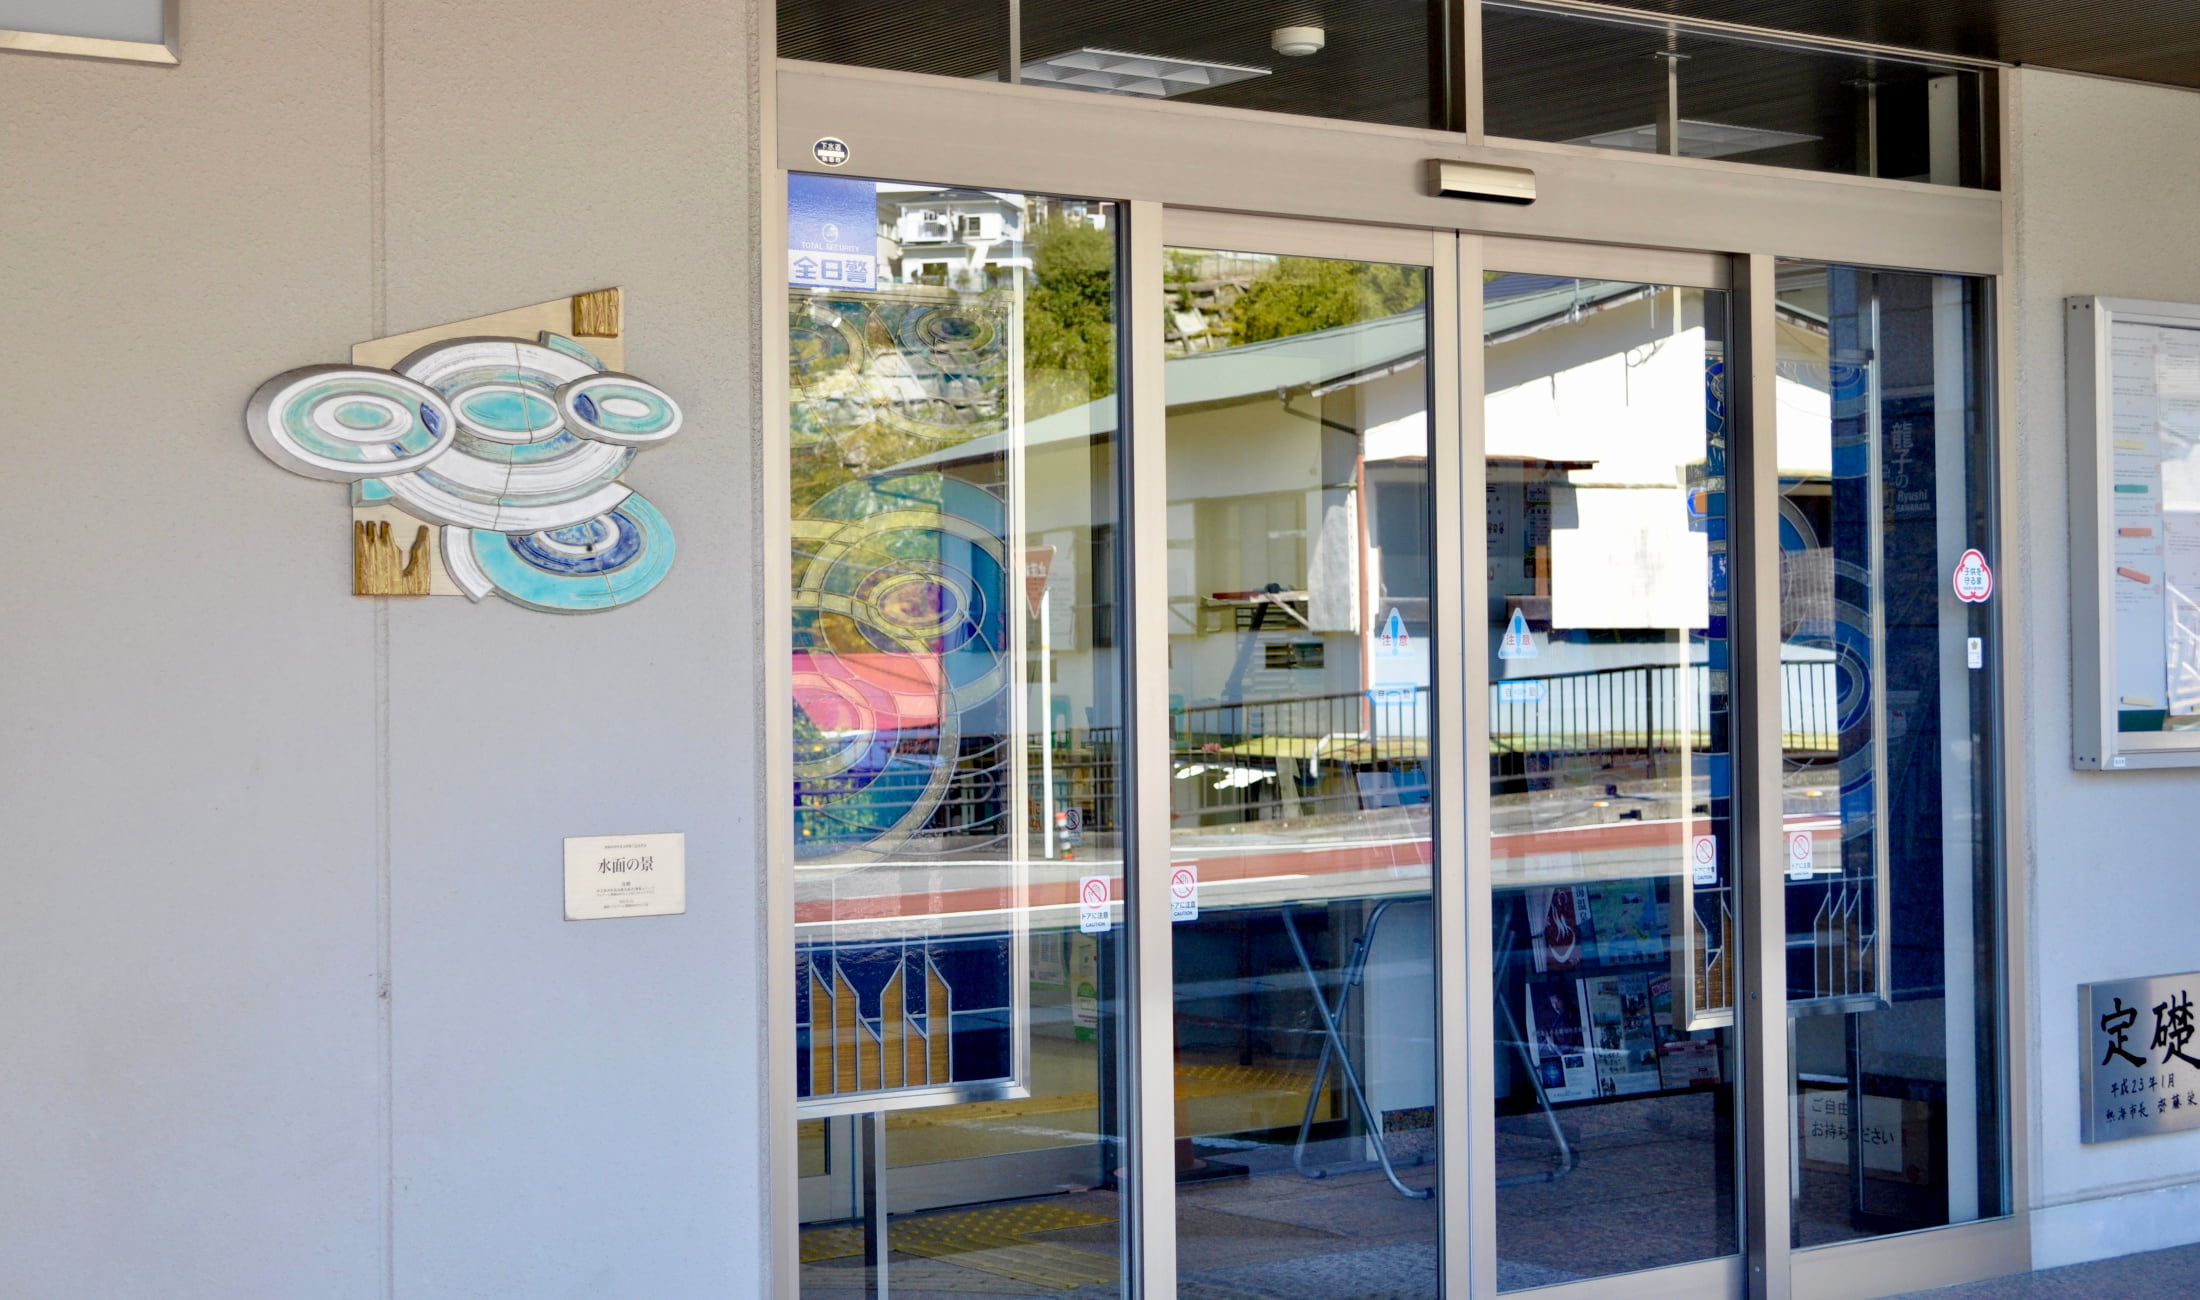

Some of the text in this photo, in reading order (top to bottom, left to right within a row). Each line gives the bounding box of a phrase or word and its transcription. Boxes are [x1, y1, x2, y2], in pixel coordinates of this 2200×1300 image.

[801, 241, 860, 252] TOTAL SECURITY
[793, 256, 868, 283] 全日警
[1891, 422, 1914, 488] 龍子の
[1897, 488, 1928, 503] Ryushi
[1382, 634, 1409, 646] 注意
[1506, 634, 1531, 646] 注意
[597, 856, 654, 874] 水面の景
[1082, 912, 1109, 920] ドアに注意
[2101, 990, 2200, 1069] 定礎
[2110, 1073, 2176, 1098] 平成23年1月
[1812, 1097, 1848, 1116] ご自由
[1811, 1121, 1894, 1145] お持ちださい
